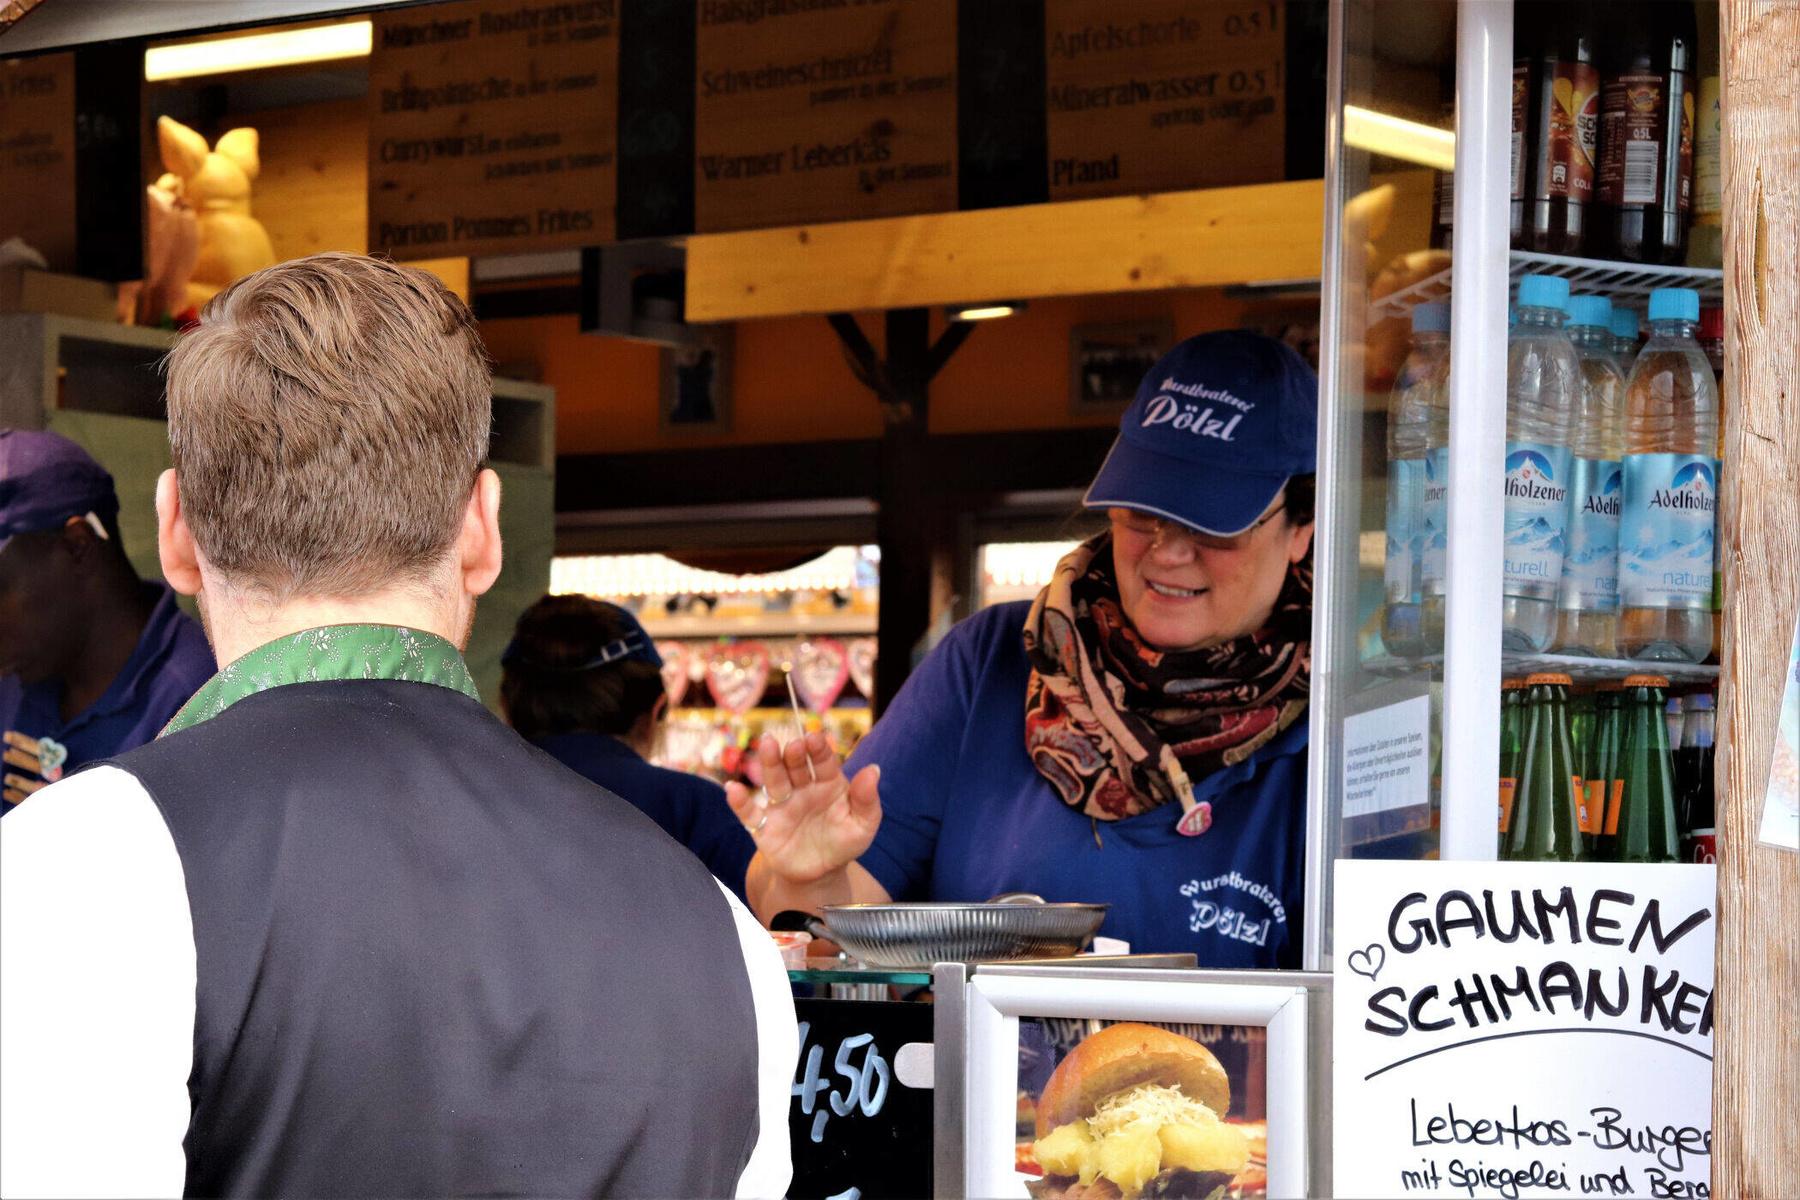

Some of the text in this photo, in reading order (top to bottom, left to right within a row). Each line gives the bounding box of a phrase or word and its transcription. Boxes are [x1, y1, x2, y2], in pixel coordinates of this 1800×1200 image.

[1051, 16, 1201, 59] Apfelschorle
[702, 45, 893, 97] Schweineschnitzel
[1050, 72, 1220, 112] Mineralwasser
[700, 151, 785, 180] Warmer
[1053, 154, 1119, 186] Pfand
[380, 208, 594, 247] Portion Pommes Frites
[1141, 395, 1243, 441] Pölzl
[1179, 870, 1286, 924] Wurstbraterei
[1189, 898, 1271, 947] Pölzl
[1387, 886, 1712, 955] GAUMEN
[791, 1020, 891, 1143] 4,50
[1402, 1158, 1443, 1190] mit
[1448, 1159, 1570, 1199] Spiegelei
[1580, 1165, 1634, 1194] und
